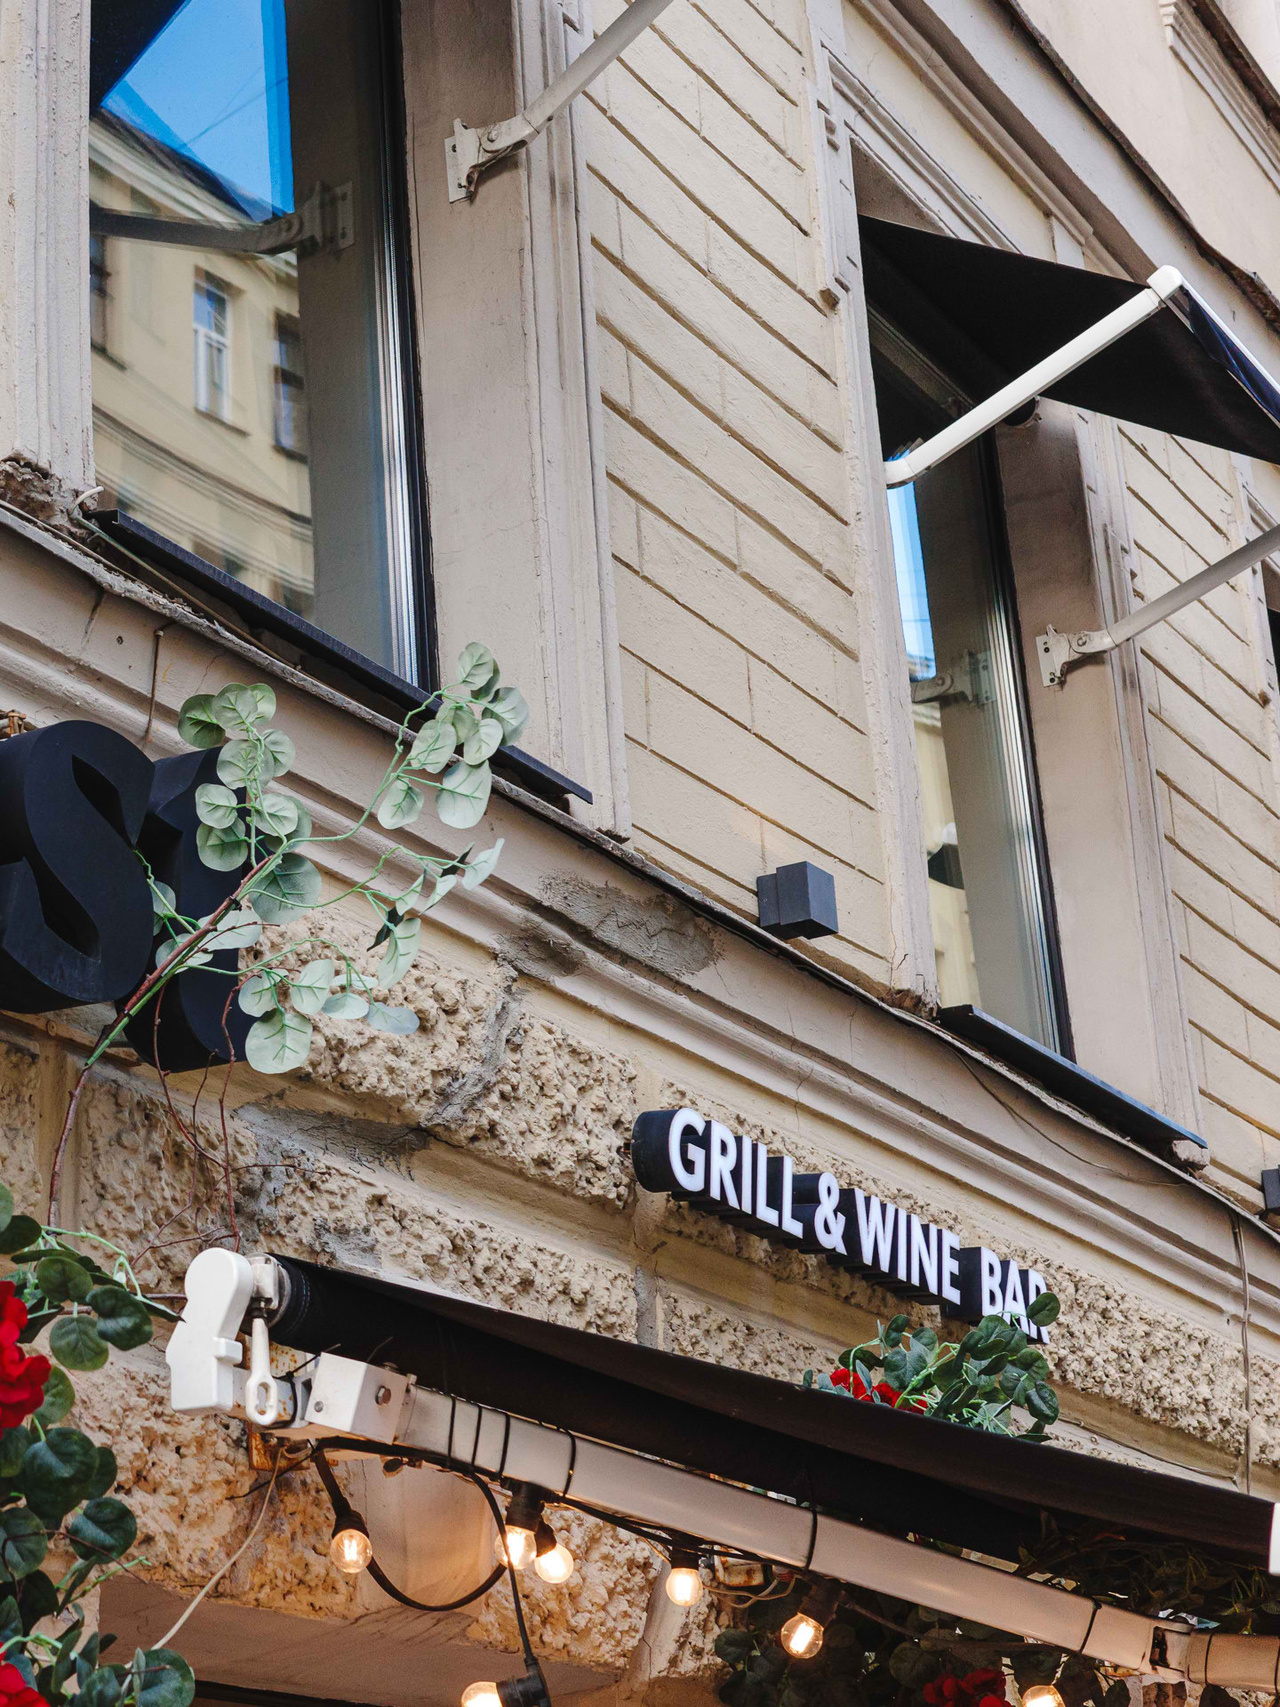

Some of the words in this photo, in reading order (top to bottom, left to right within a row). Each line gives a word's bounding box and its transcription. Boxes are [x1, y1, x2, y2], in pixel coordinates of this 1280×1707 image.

[669, 1107, 803, 1239] GRILL
[814, 1172, 847, 1256] &
[854, 1188, 961, 1306] WINE
[980, 1246, 1051, 1345] BAR
